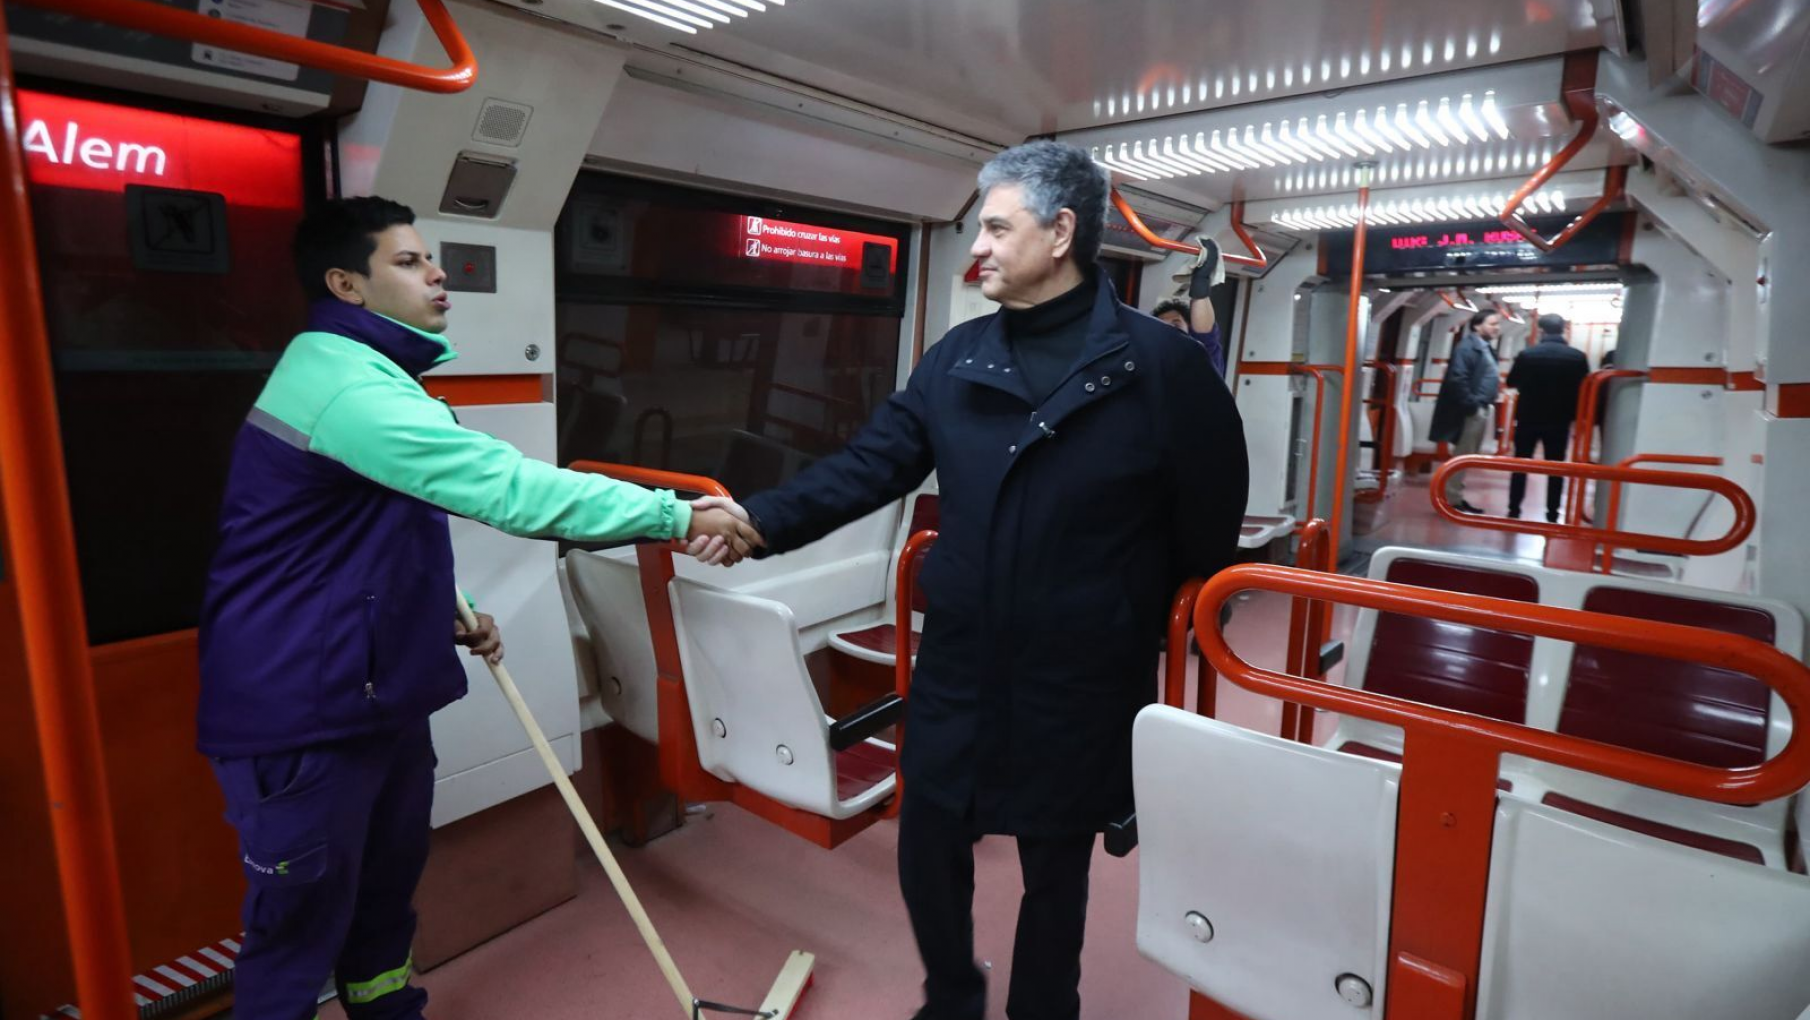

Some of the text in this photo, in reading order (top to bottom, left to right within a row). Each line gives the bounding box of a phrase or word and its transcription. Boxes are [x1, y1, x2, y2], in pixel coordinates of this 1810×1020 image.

[23, 119, 166, 176] Alem
[762, 224, 796, 237] Prohibido
[797, 231, 818, 240] cruzar
[819, 232, 828, 242] las
[761, 244, 772, 253] No
[773, 246, 796, 257] arrojar
[797, 248, 819, 259] basura
[825, 251, 835, 260] las
